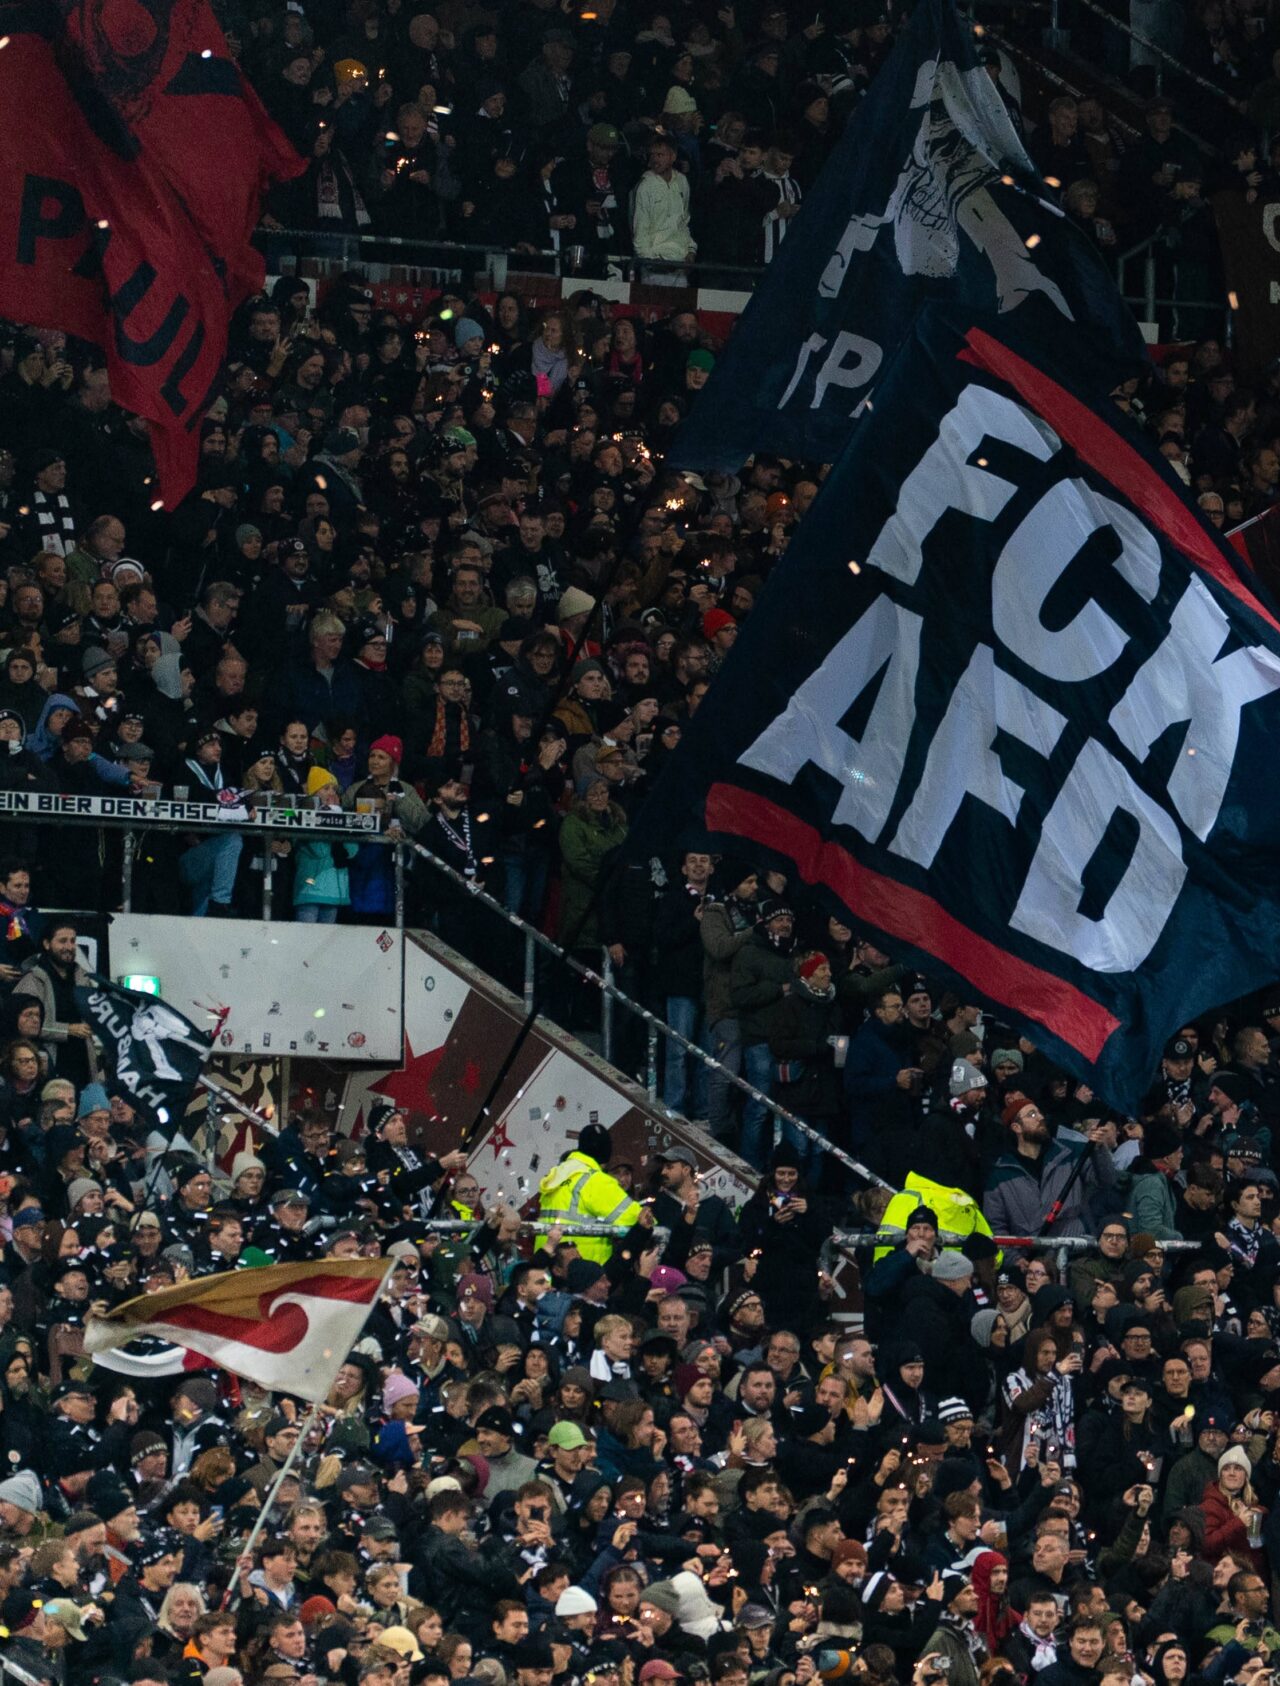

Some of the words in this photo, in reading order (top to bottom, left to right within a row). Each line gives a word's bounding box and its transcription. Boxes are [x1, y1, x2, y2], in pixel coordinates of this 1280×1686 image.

[38, 795, 90, 815] BIER
[100, 799, 148, 816] DEN
[154, 802, 313, 827] FASCTEN!
[736, 592, 1188, 973] AFD
